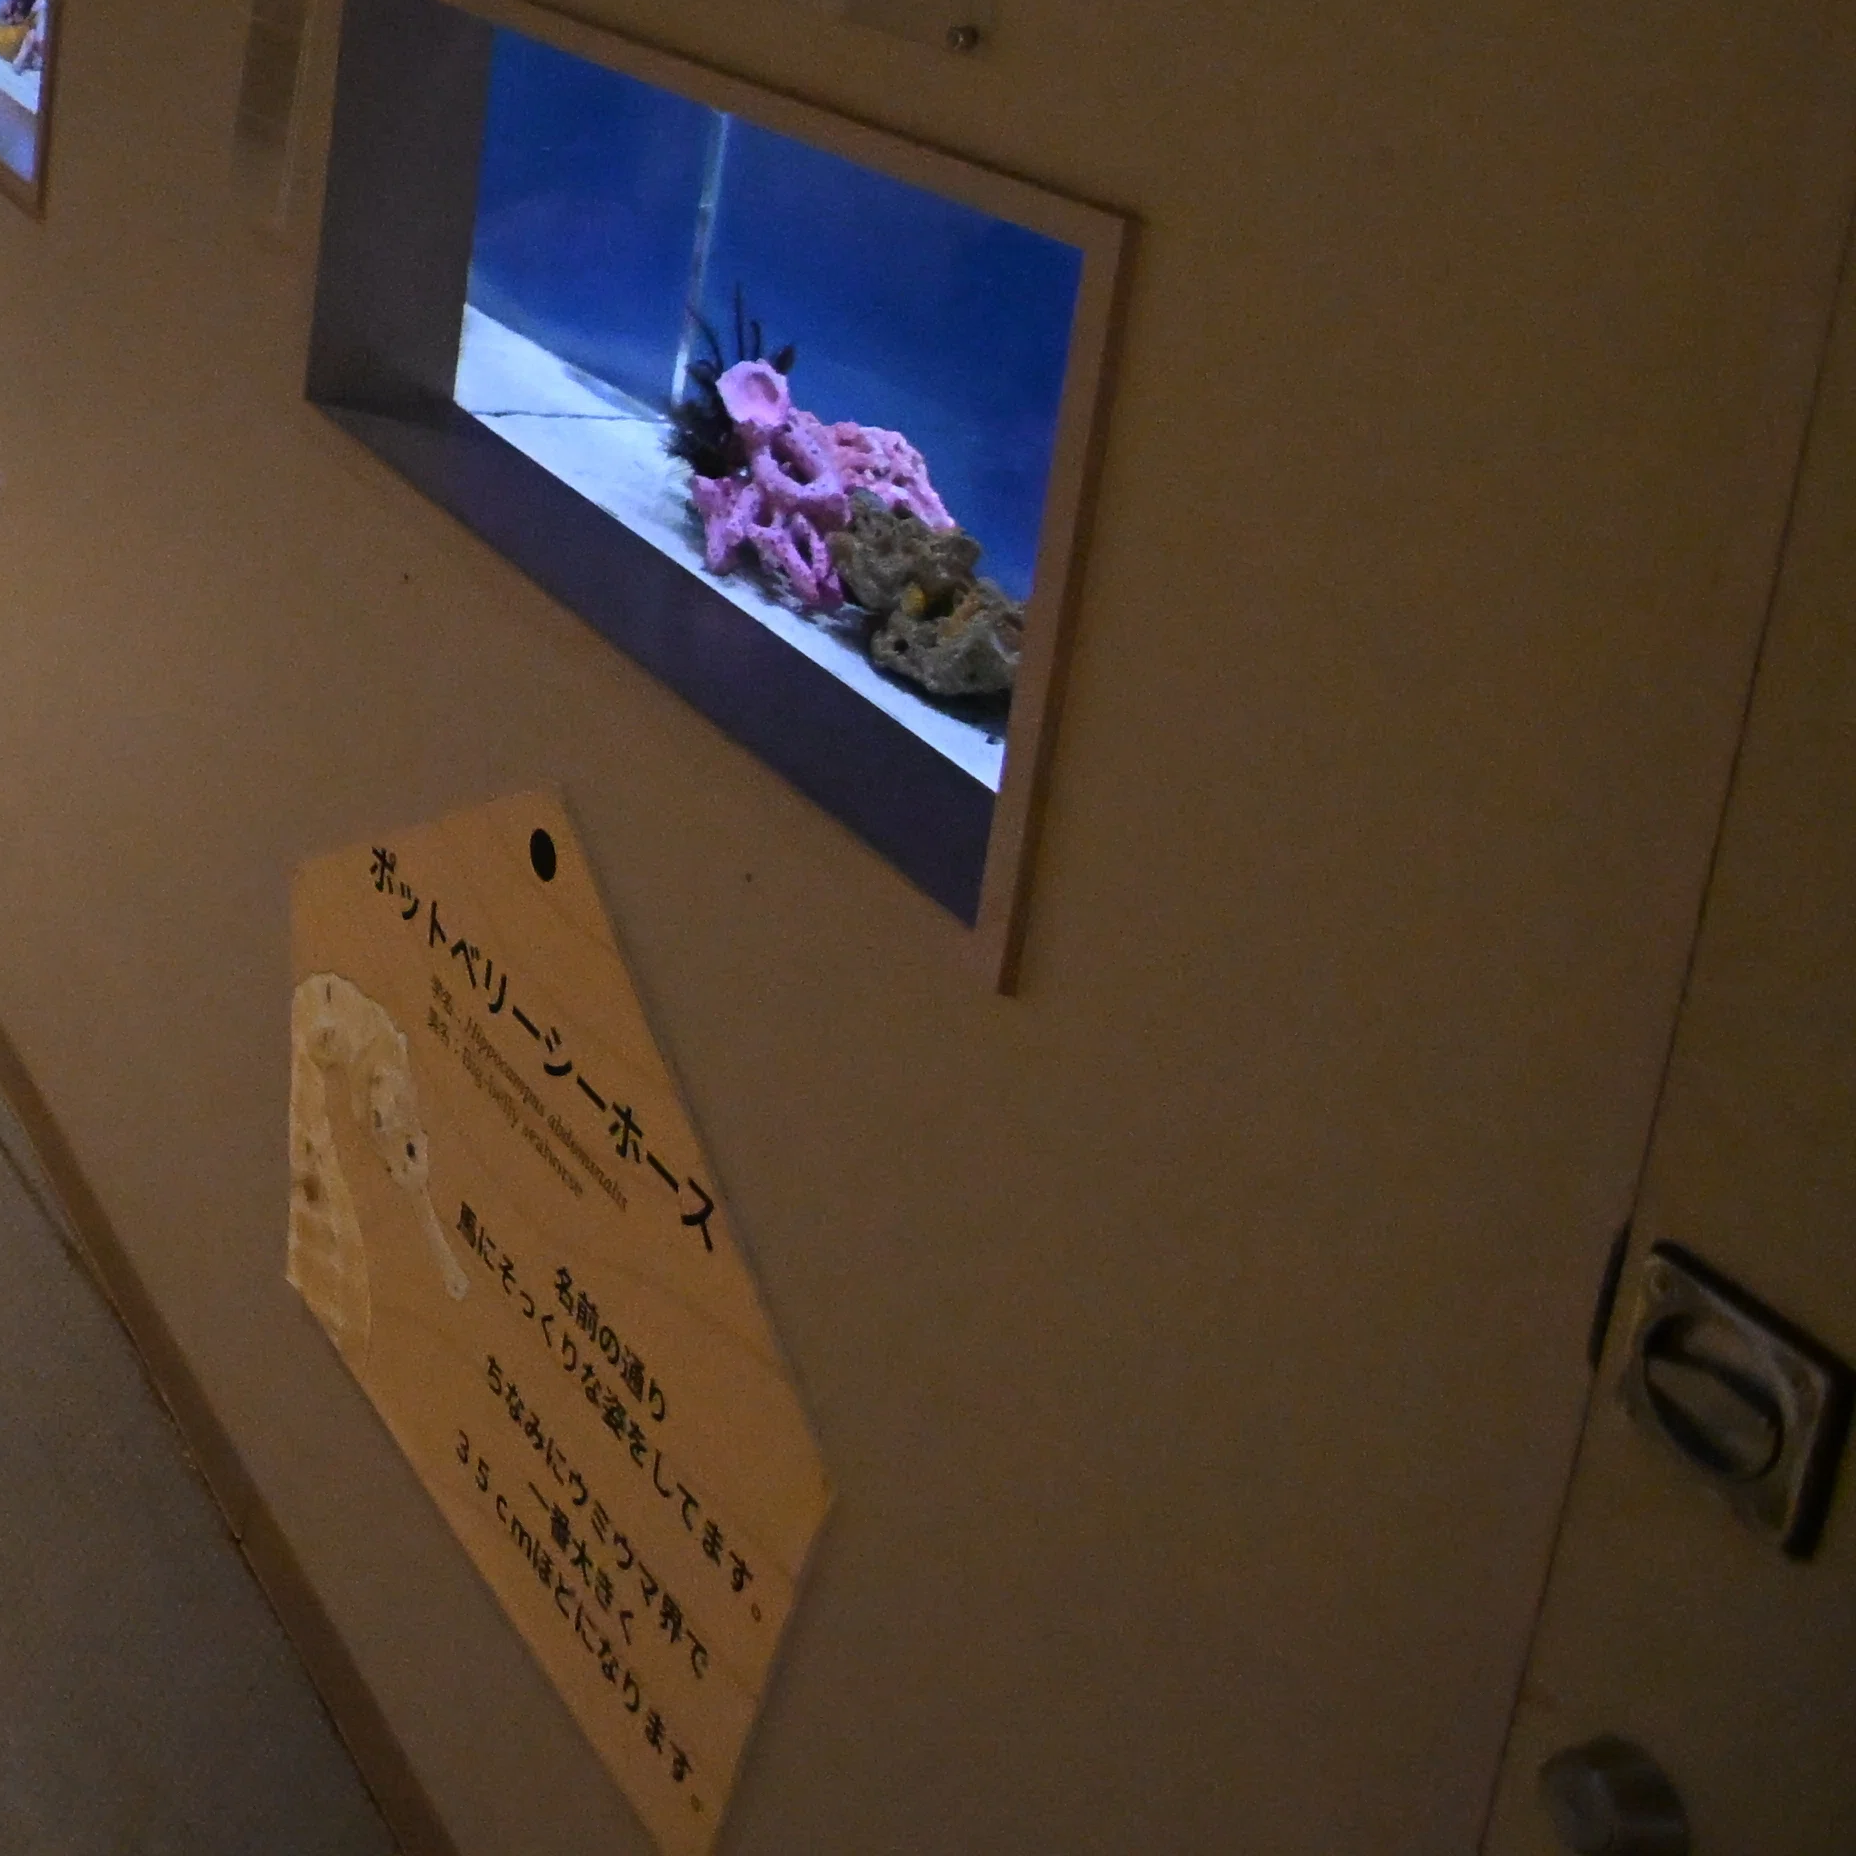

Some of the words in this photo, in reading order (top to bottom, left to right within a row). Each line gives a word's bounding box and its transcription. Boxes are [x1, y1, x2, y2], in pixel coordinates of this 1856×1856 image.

[369, 846, 714, 1252] ポットベリーシーホース
[457, 1201, 761, 1623] 馬にそっくりな姿をしてます。
[555, 1266, 666, 1422] 名前の通り
[488, 1355, 708, 1680] ちなみにウミウマ界で
[529, 1482, 634, 1646] 一番大きく
